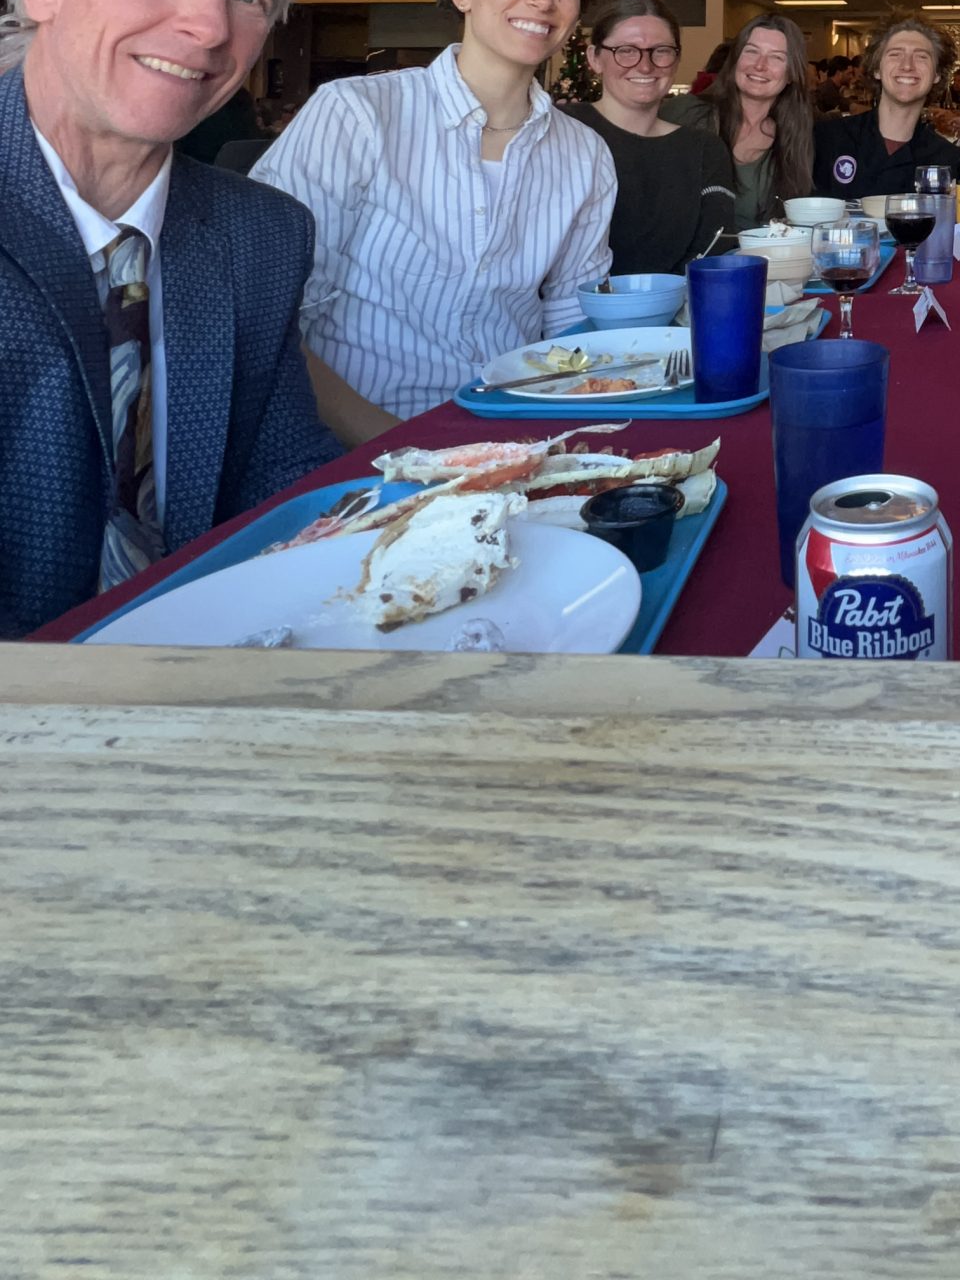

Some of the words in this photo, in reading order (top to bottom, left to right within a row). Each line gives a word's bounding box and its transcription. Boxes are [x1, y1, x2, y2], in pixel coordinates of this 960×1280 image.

[834, 588, 904, 627] Pabst
[810, 619, 854, 657] Blue
[857, 628, 932, 658] Ribbon
